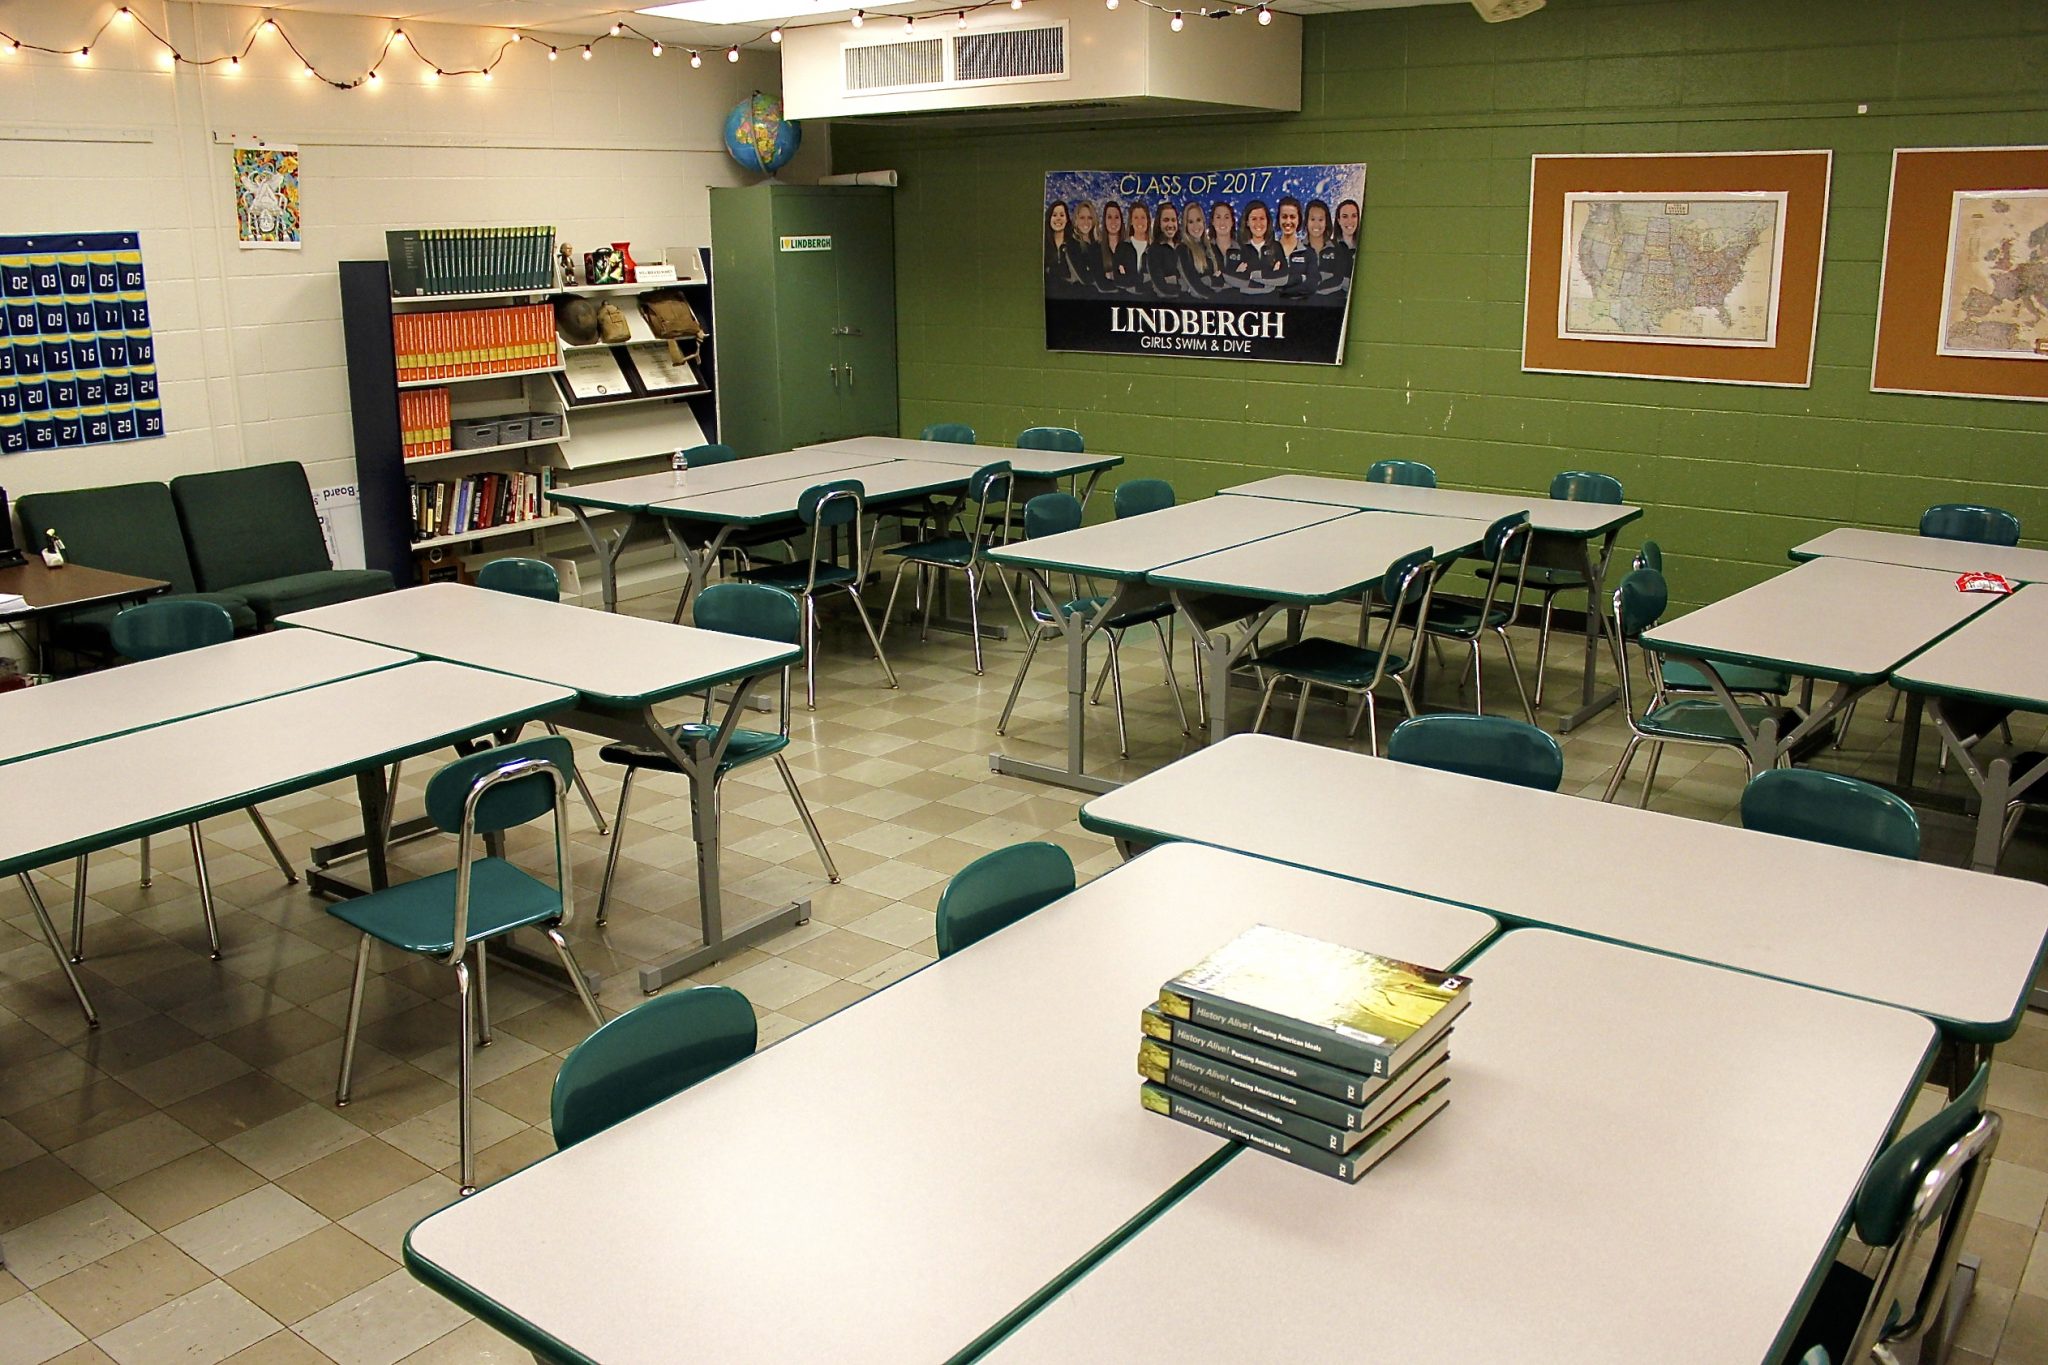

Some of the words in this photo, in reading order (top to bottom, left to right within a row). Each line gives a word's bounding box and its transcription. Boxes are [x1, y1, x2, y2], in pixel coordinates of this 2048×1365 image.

[1120, 174, 1182, 195] CLASS
[1189, 174, 1217, 195] OF
[1221, 172, 1272, 194] 2017
[791, 238, 831, 249] LINDBERGH
[12, 276, 28, 289] 02
[41, 274, 57, 288] 03
[71, 274, 86, 288] 04
[99, 273, 114, 287] 05
[127, 272, 141, 285] 06
[18, 314, 34, 328] 08
[47, 313, 63, 326] 09
[76, 312, 90, 325] 10
[105, 310, 119, 323] 11
[132, 309, 146, 322] 12
[1110, 306, 1286, 339] LINDBERGH
[24, 353, 39, 367] 14
[54, 351, 68, 364] 15
[81, 348, 95, 362] 16
[110, 347, 124, 360] 17
[137, 346, 151, 359] 18
[1140, 336, 1172, 349] GIRLS
[1175, 337, 1207, 351] SWIM
[1210, 339, 1220, 351] &
[1223, 339, 1252, 353] DIVE
[0, 393, 16, 407] 19
[28, 390, 43, 404] 20
[59, 387, 73, 401] 21
[87, 386, 102, 399] 22
[114, 383, 129, 396] 23
[140, 380, 154, 393] 24
[8, 433, 23, 447] 25
[37, 428, 52, 442] 26
[62, 426, 78, 439] 27
[92, 422, 107, 435] 28
[117, 420, 132, 433] 29
[146, 418, 160, 431] 30
[323, 486, 355, 501] Board
[1196, 1007, 1226, 1024] History
[1228, 1017, 1252, 1031] Alive!
[1253, 1026, 1277, 1040] Pursuing
[1277, 1033, 1304, 1047] American
[1304, 1041, 1322, 1052] Ideals
[1177, 1029, 1206, 1047] History
[1206, 1040, 1230, 1055] Alive!
[1231, 1050, 1255, 1064] Pursuing
[1255, 1057, 1281, 1071] American
[1280, 1065, 1298, 1077] Ideals
[1176, 1058, 1205, 1075] History
[1206, 1068, 1230, 1082] Alive!
[1230, 1078, 1254, 1092] Pursuing
[1254, 1086, 1280, 1099] American
[1280, 1094, 1297, 1105] Ideals
[1171, 1073, 1198, 1091] History
[1198, 1084, 1220, 1099] Alive!
[1221, 1095, 1243, 1110] Pursuing
[1243, 1104, 1268, 1118] American
[1267, 1113, 1283, 1125] Ideals
[1175, 1105, 1203, 1121] History
[1203, 1116, 1226, 1130] Alive!
[1227, 1125, 1250, 1140] Pursuing
[1250, 1133, 1275, 1147] American
[1274, 1143, 1291, 1154] Ideals
